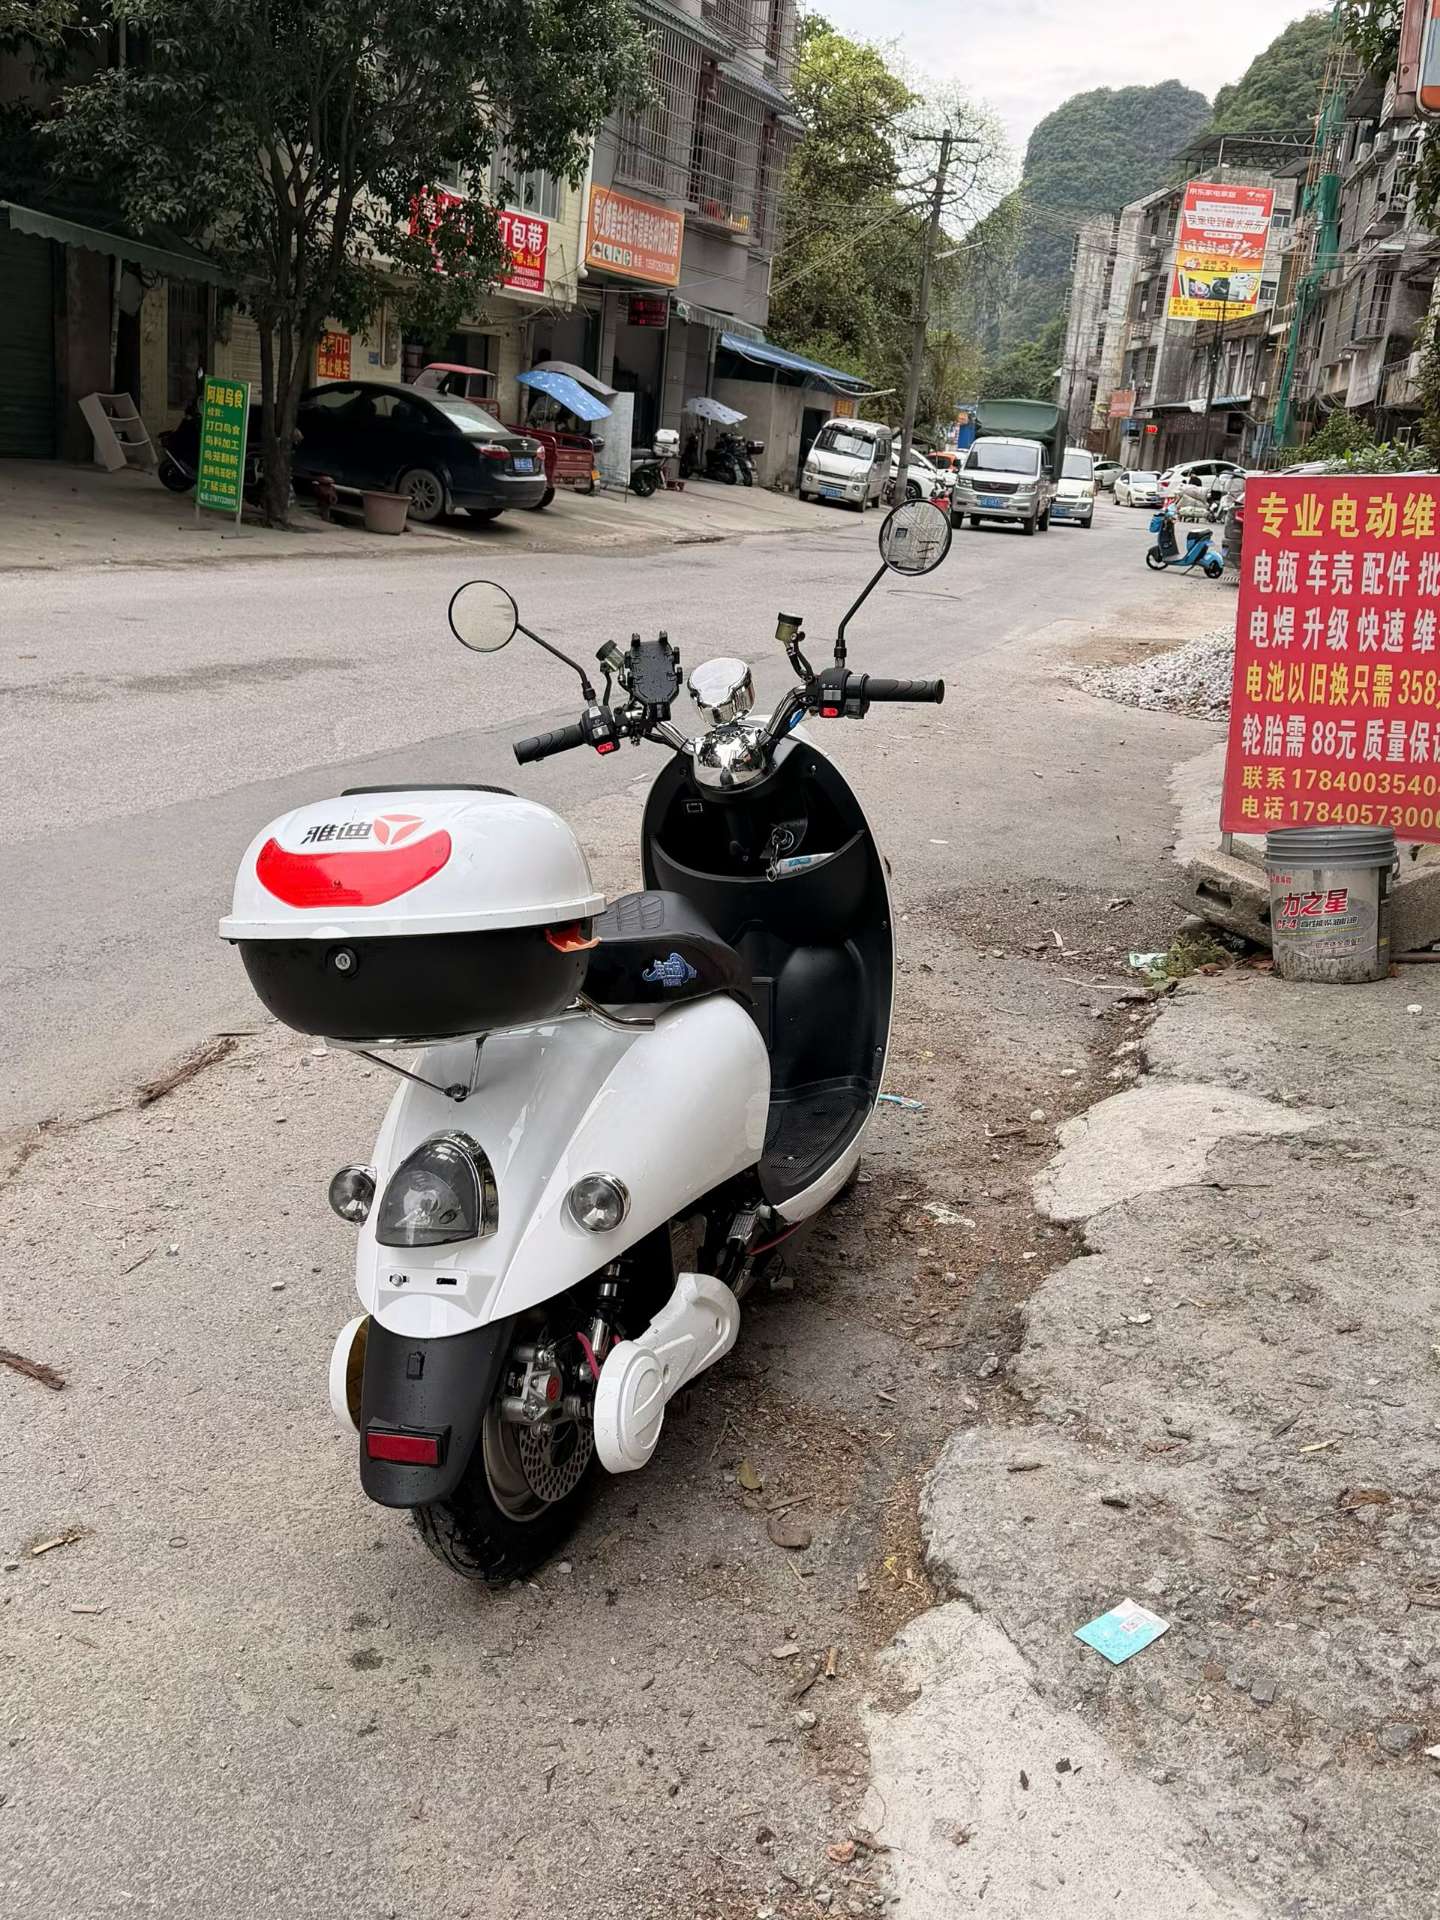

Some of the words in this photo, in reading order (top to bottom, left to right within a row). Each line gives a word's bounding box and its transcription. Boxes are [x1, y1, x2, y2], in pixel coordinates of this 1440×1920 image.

[1258, 491, 1437, 539] 专业电动维
[1254, 549, 1299, 594] 电瓶
[1306, 550, 1354, 595] 车壳
[1361, 551, 1410, 596] 配件
[1250, 605, 1295, 649] 电焊
[1303, 606, 1349, 650] 升级
[1357, 608, 1406, 653] 快速
[1412, 608, 1440, 654] 维
[1246, 659, 1440, 708] 电池以旧换只需358
[1242, 765, 1286, 790] 联系
[1292, 769, 1440, 796] 1784003540
[1242, 795, 1285, 820] 电话
[300, 822, 372, 845] 雅迪
[1280, 888, 1348, 917] 力之星
